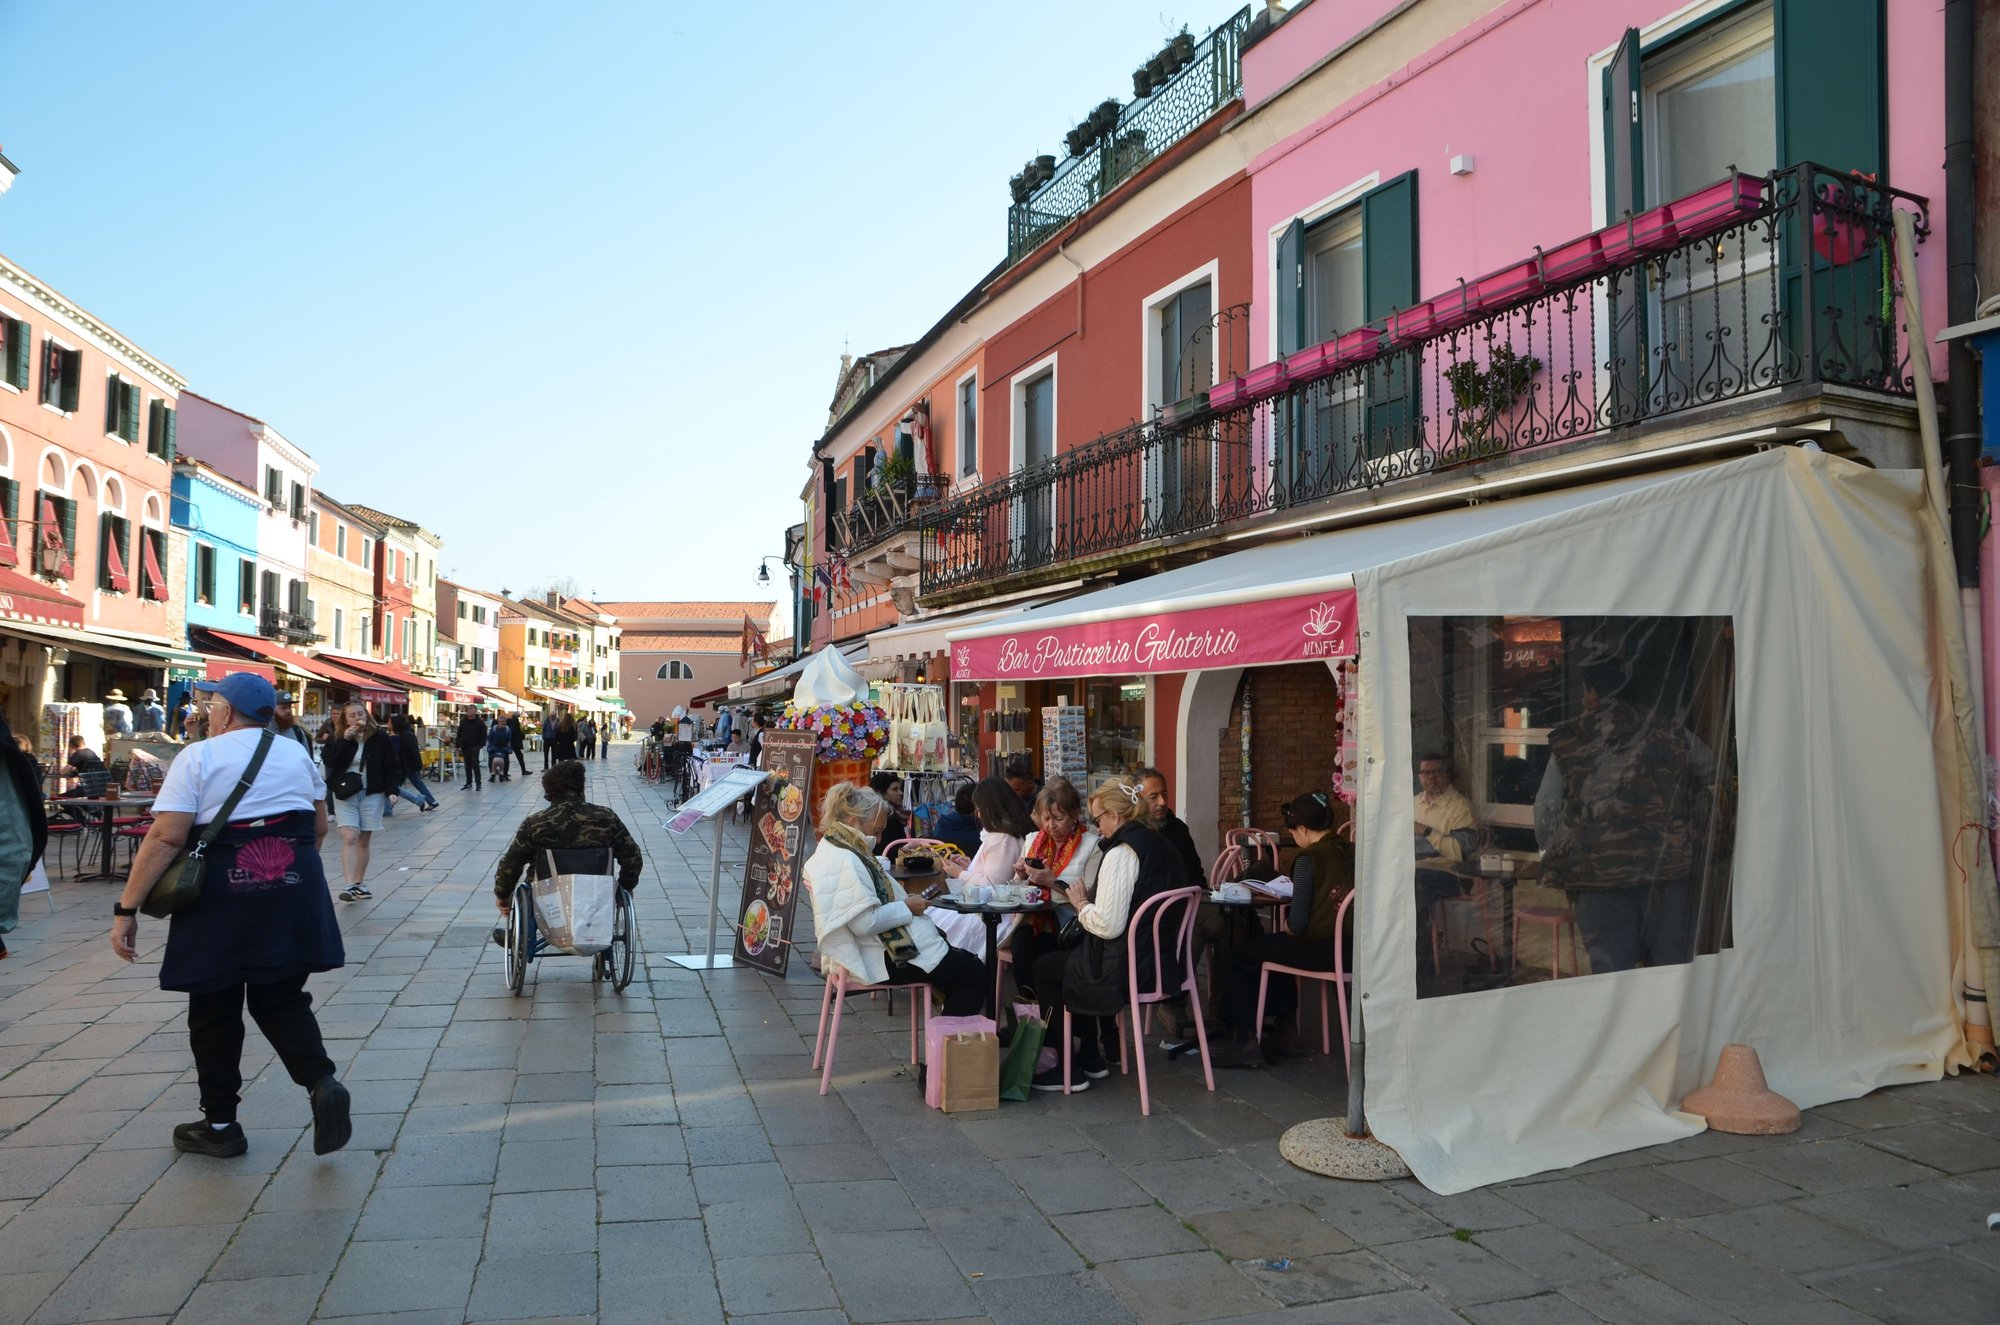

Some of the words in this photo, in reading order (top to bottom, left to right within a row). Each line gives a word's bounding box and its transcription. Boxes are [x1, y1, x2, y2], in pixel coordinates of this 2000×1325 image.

[997, 637, 1032, 672] Bar
[1032, 635, 1132, 674] Pasticceria
[1134, 622, 1239, 669] Gelateria
[1302, 639, 1345, 656] NINFEA
